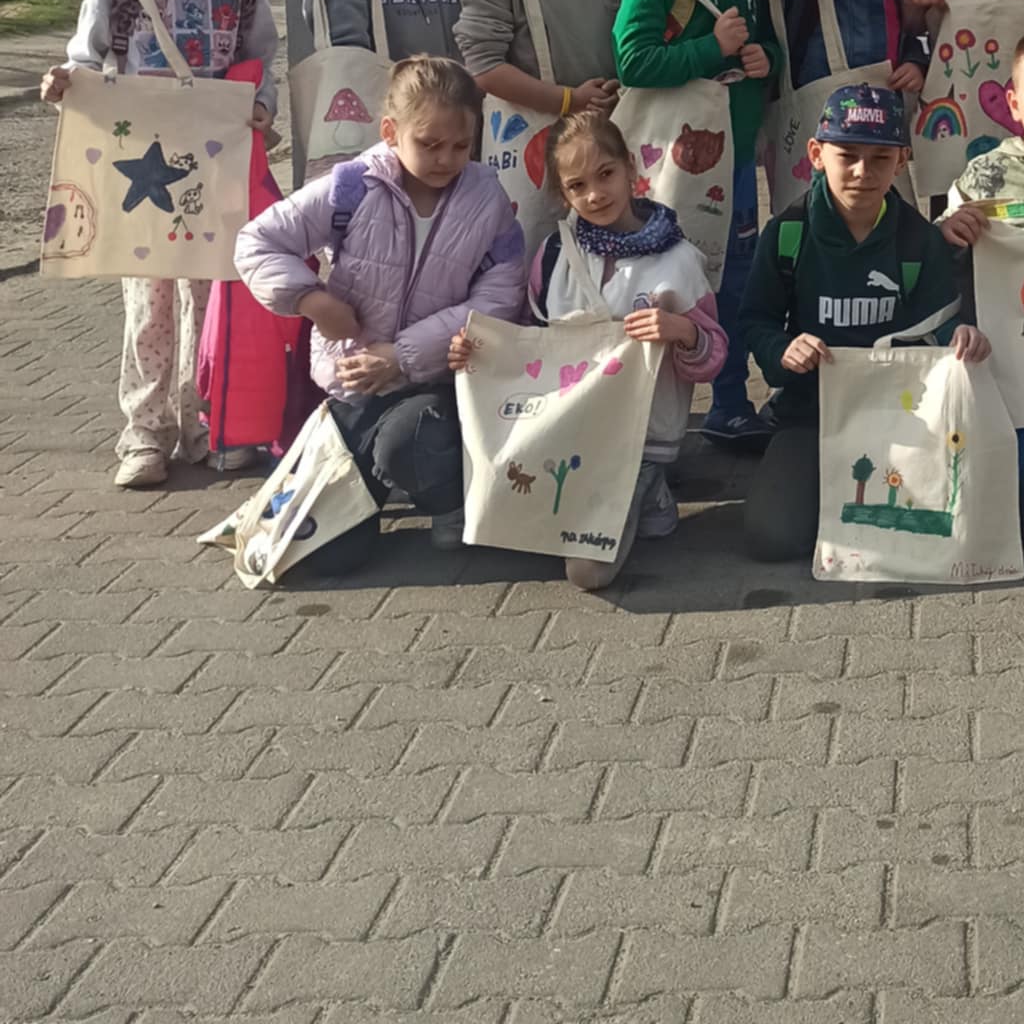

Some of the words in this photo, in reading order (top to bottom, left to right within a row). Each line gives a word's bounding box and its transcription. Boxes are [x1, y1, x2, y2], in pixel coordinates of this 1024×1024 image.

[846, 106, 885, 124] MARVEL
[784, 119, 800, 154] LOVE
[818, 296, 896, 327] PUMA
